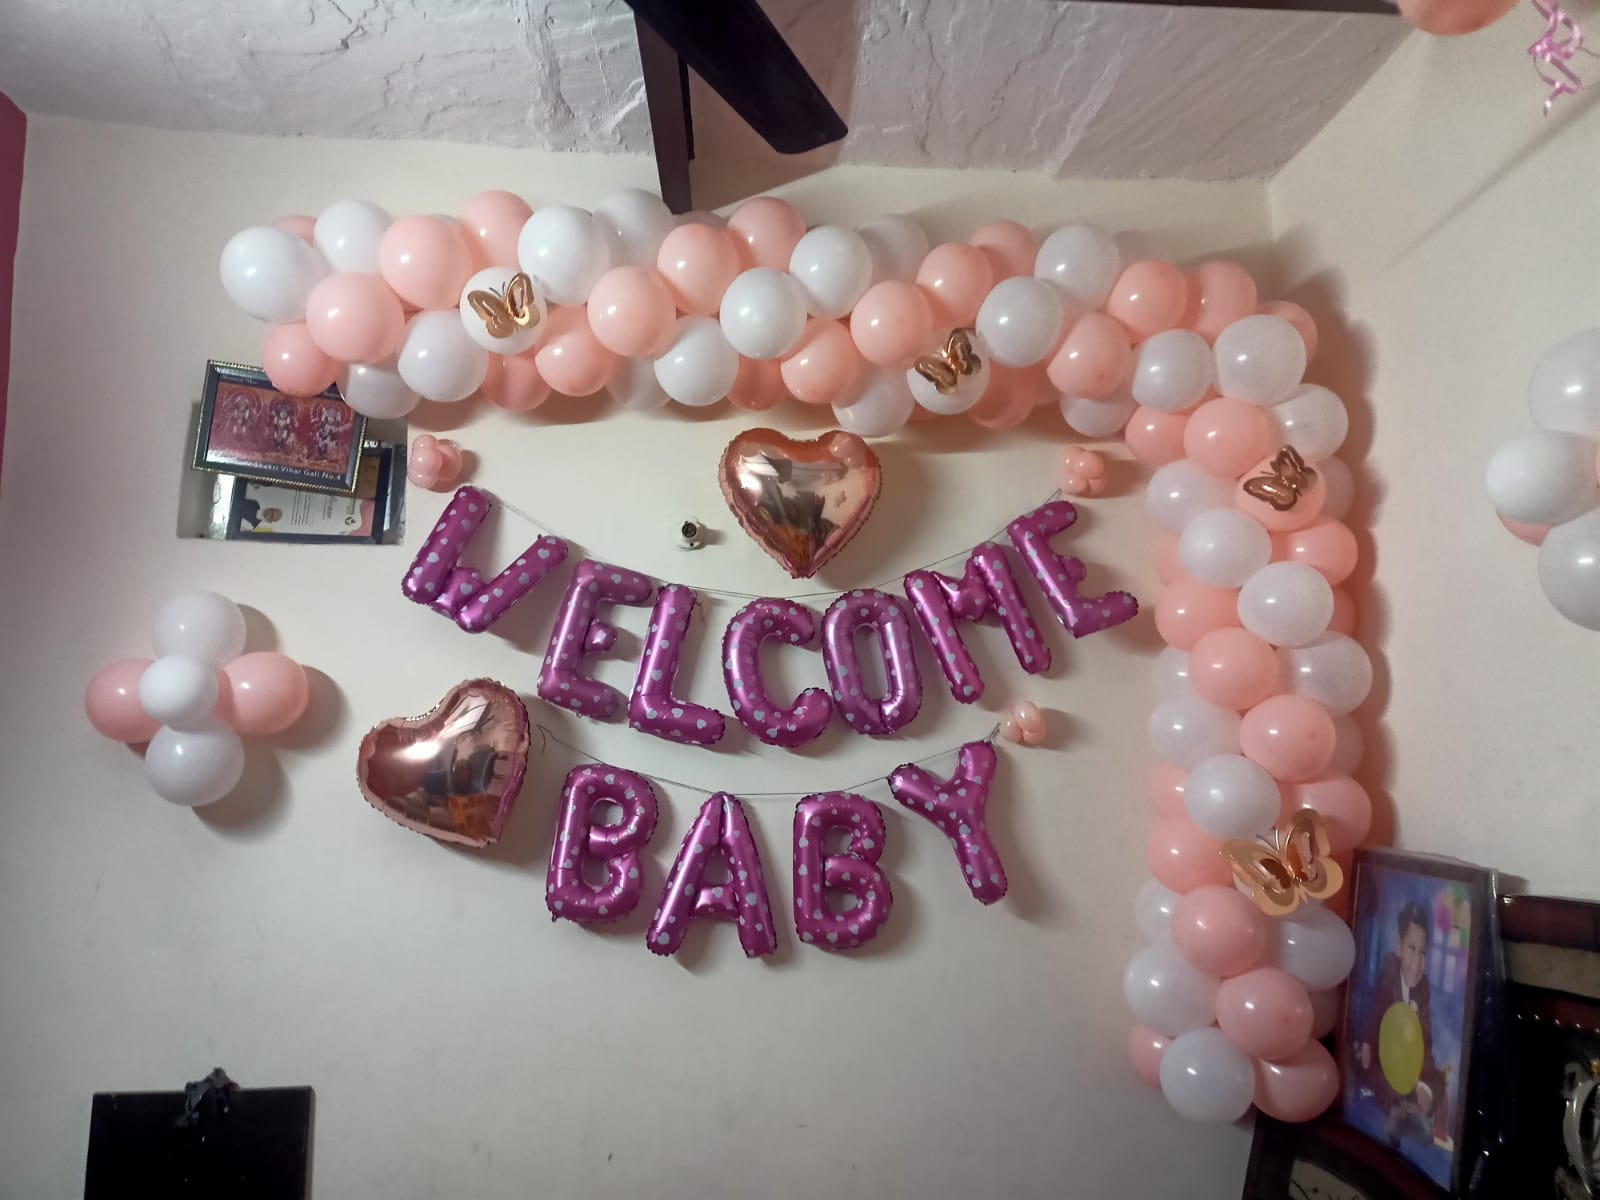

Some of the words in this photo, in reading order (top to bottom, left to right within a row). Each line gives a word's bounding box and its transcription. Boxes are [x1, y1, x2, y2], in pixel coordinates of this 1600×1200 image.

[322, 472, 342, 481] No.4
[401, 485, 1138, 748] WELCOME
[546, 739, 1008, 958] BABY
